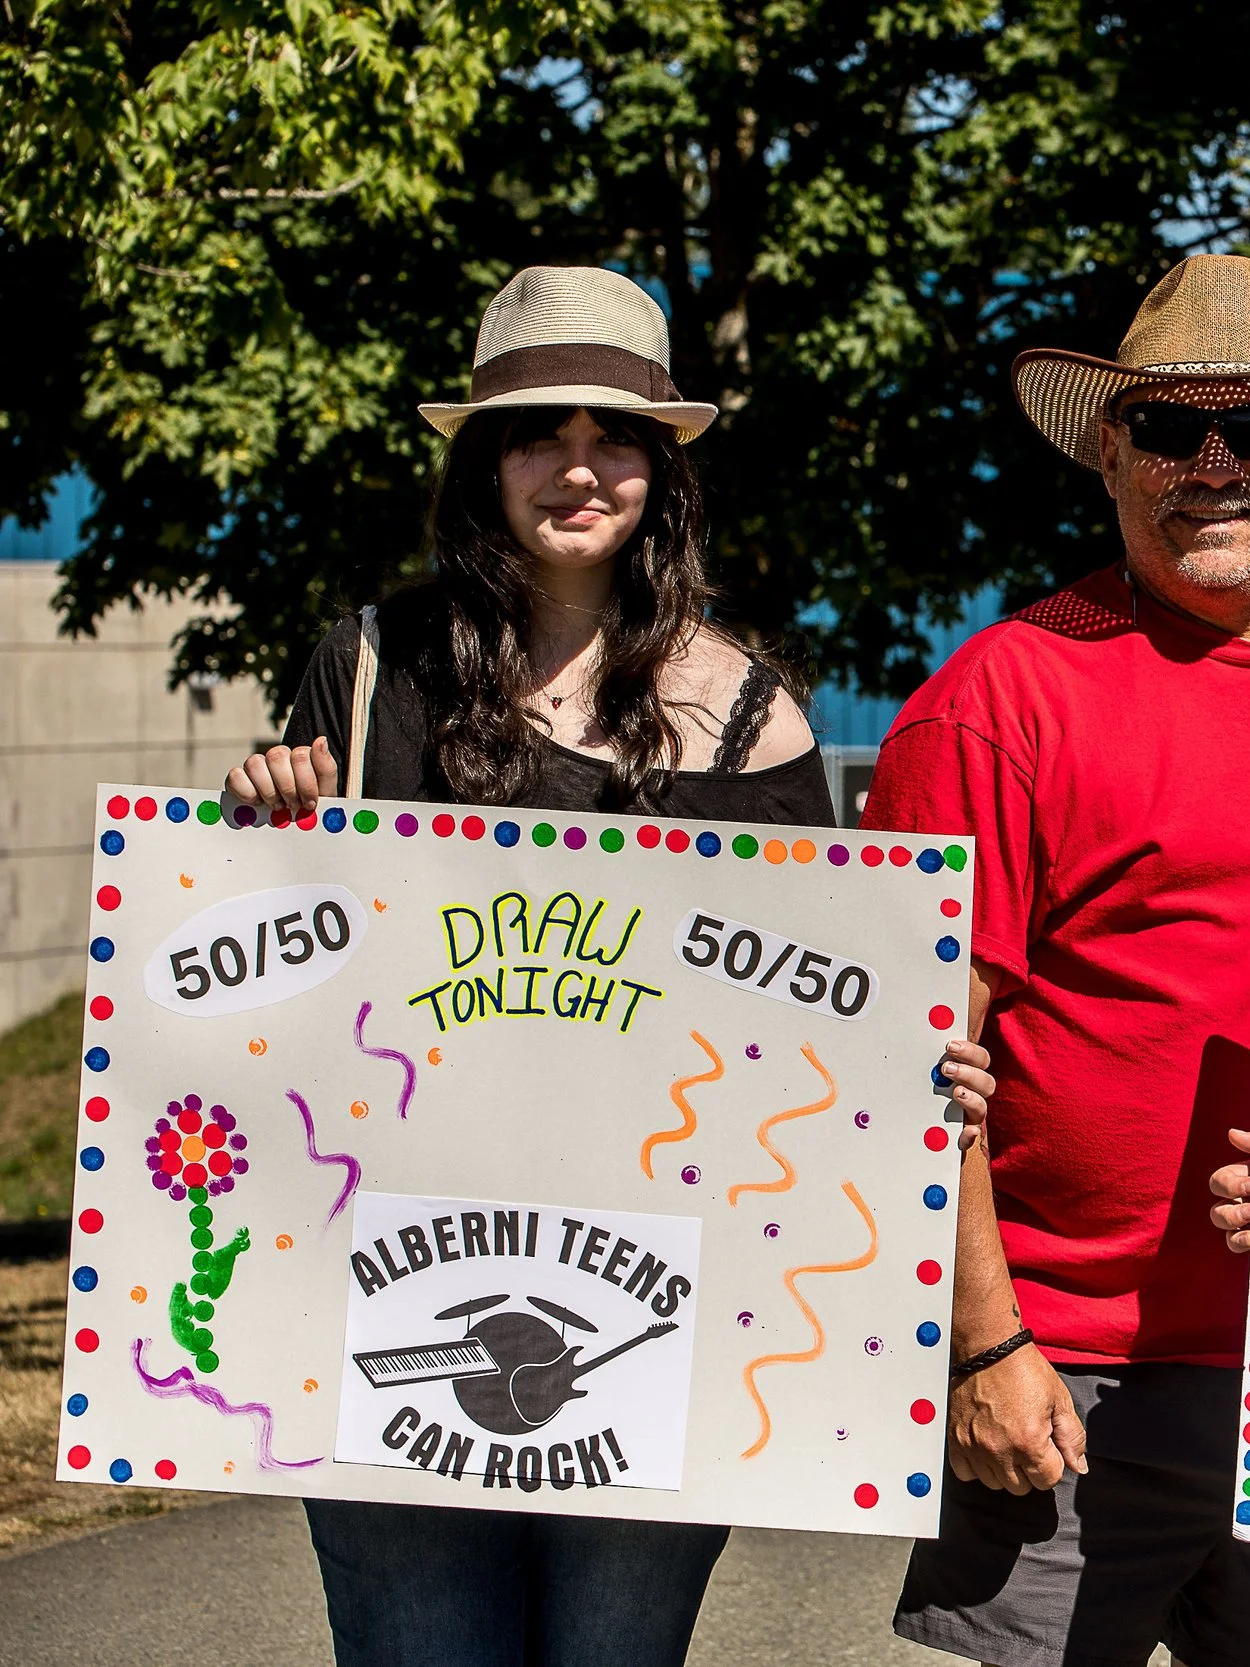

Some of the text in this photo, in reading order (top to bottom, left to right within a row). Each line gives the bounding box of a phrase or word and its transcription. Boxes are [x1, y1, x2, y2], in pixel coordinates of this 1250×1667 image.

[169, 900, 350, 1000] 50/50
[441, 891, 642, 969] DRAW
[682, 913, 870, 1017] 50/50
[408, 967, 662, 1032] TONIGHT
[350, 1210, 692, 1318] ALBERNI TEENS
[381, 1406, 630, 1493] CAN ROCK!
